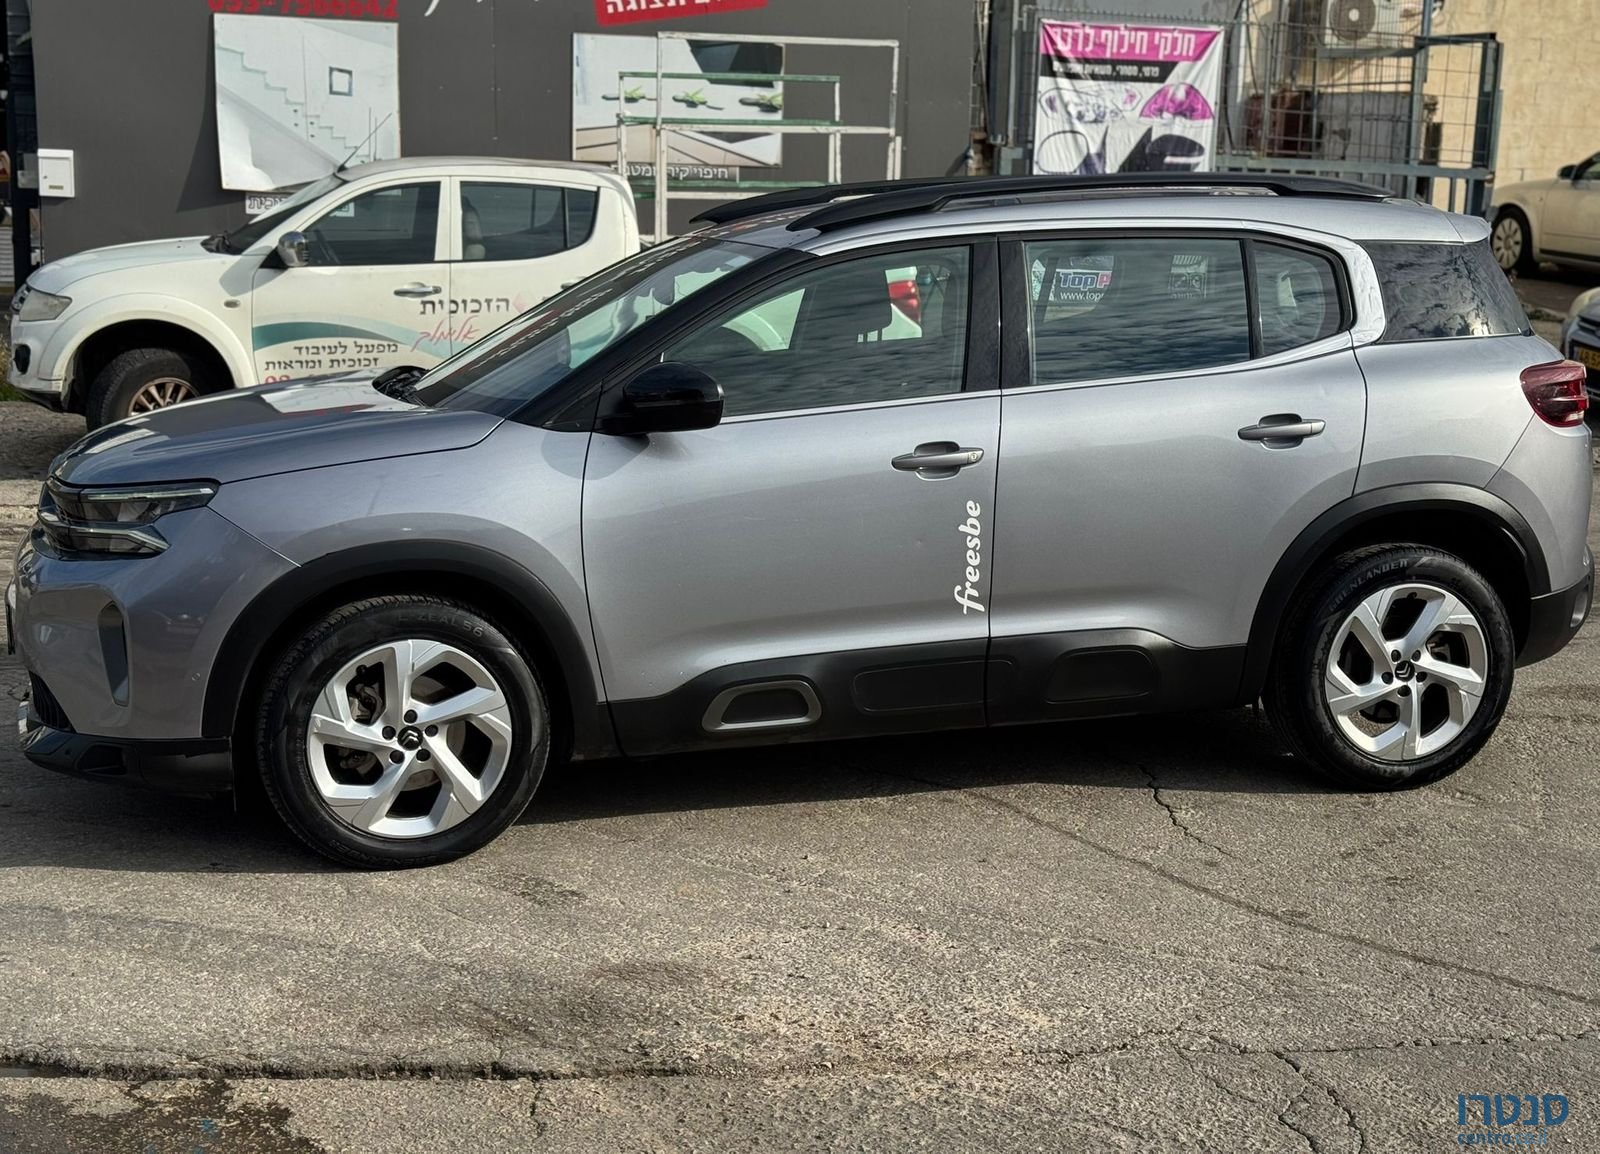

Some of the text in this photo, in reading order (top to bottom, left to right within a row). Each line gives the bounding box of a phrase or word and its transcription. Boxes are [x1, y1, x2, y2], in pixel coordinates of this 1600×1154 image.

[1101, 25, 1148, 58] חילוף
[1154, 28, 1196, 60] חלקי
[668, 165, 690, 180] קיר
[693, 166, 729, 179] חיפוי
[420, 298, 510, 315] הזכוכית
[293, 340, 398, 356] מפעל לעיבוד
[264, 357, 380, 371] זכוכית ומראות
[954, 500, 985, 615] freesbe
[463, 618, 486, 639] 56
